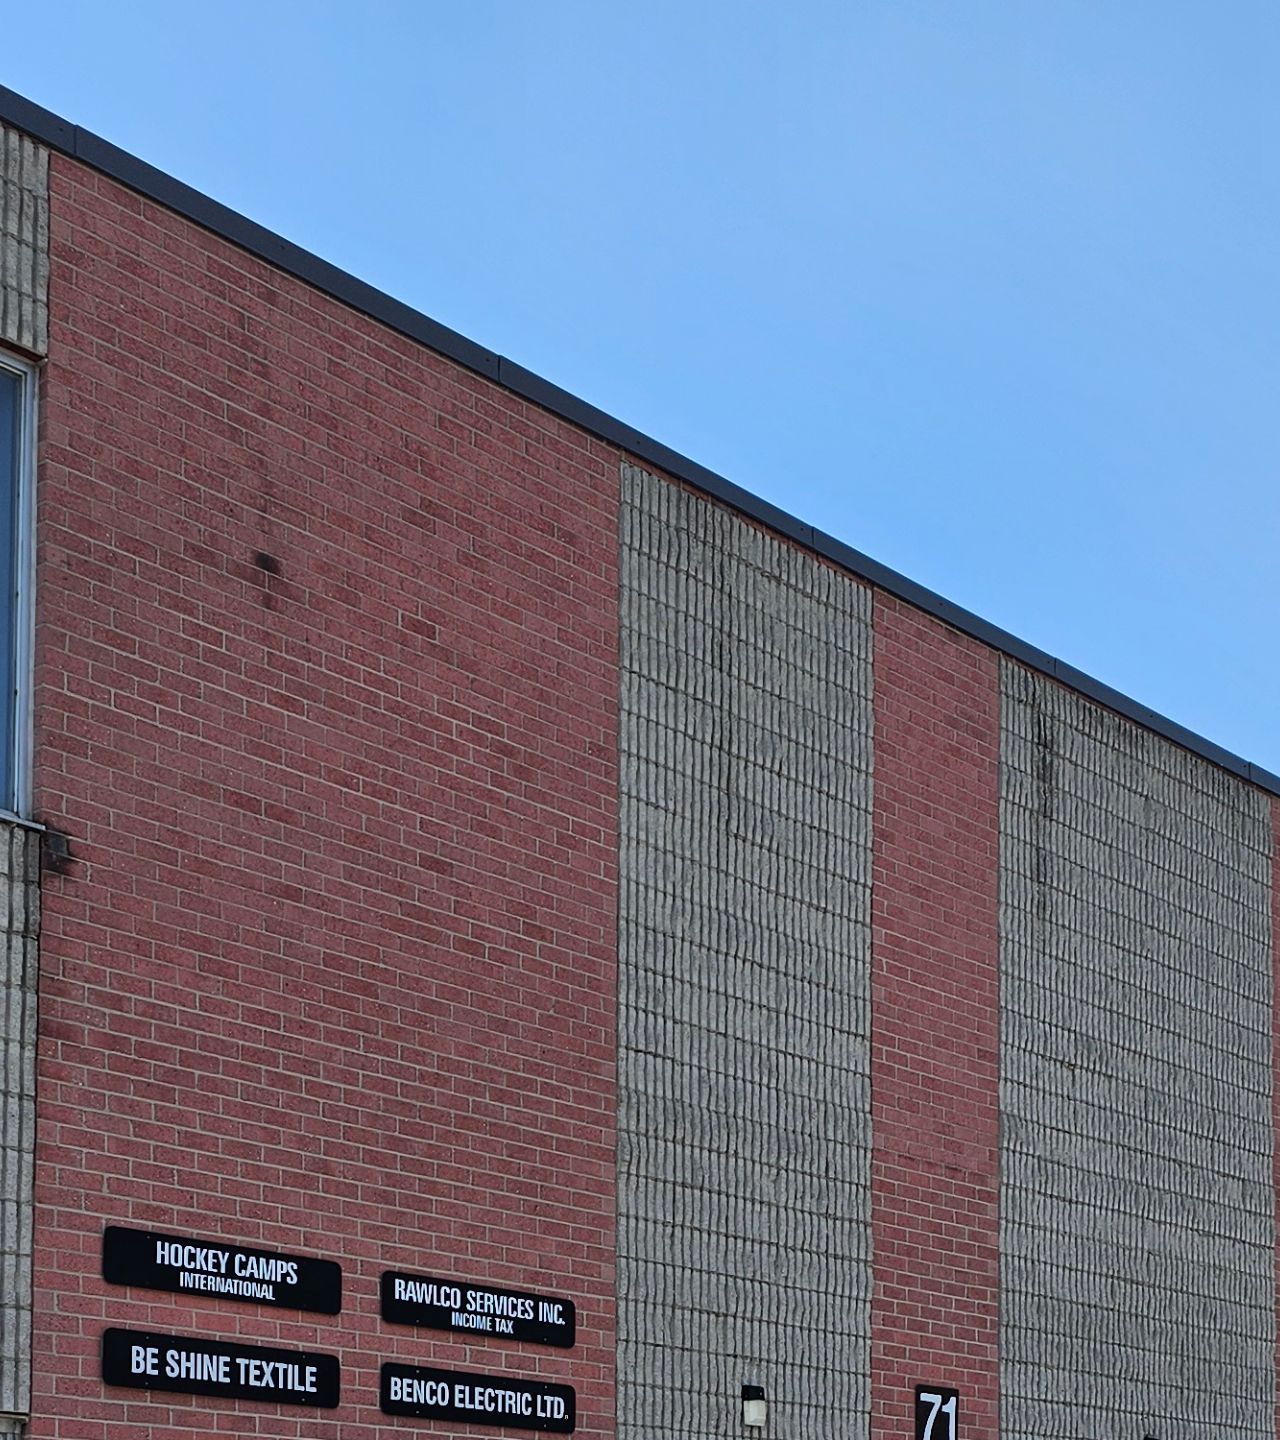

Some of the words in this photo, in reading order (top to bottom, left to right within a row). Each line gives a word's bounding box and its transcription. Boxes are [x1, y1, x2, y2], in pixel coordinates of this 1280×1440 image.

[156, 1241, 229, 1273] HOCKEY
[235, 1254, 298, 1285] CAMPS
[180, 1271, 275, 1300] INTERNATIONAL
[394, 1278, 461, 1309] RAWLCO
[466, 1290, 534, 1320] SERVICES
[538, 1302, 566, 1326] INC.
[451, 1312, 492, 1332] INCOME
[494, 1318, 514, 1334] TAX
[131, 1345, 158, 1376] BE
[166, 1350, 230, 1383] SHINE
[236, 1357, 317, 1393] TEXTILE
[390, 1376, 449, 1407] BENCO
[454, 1384, 532, 1416] ELECTRIC
